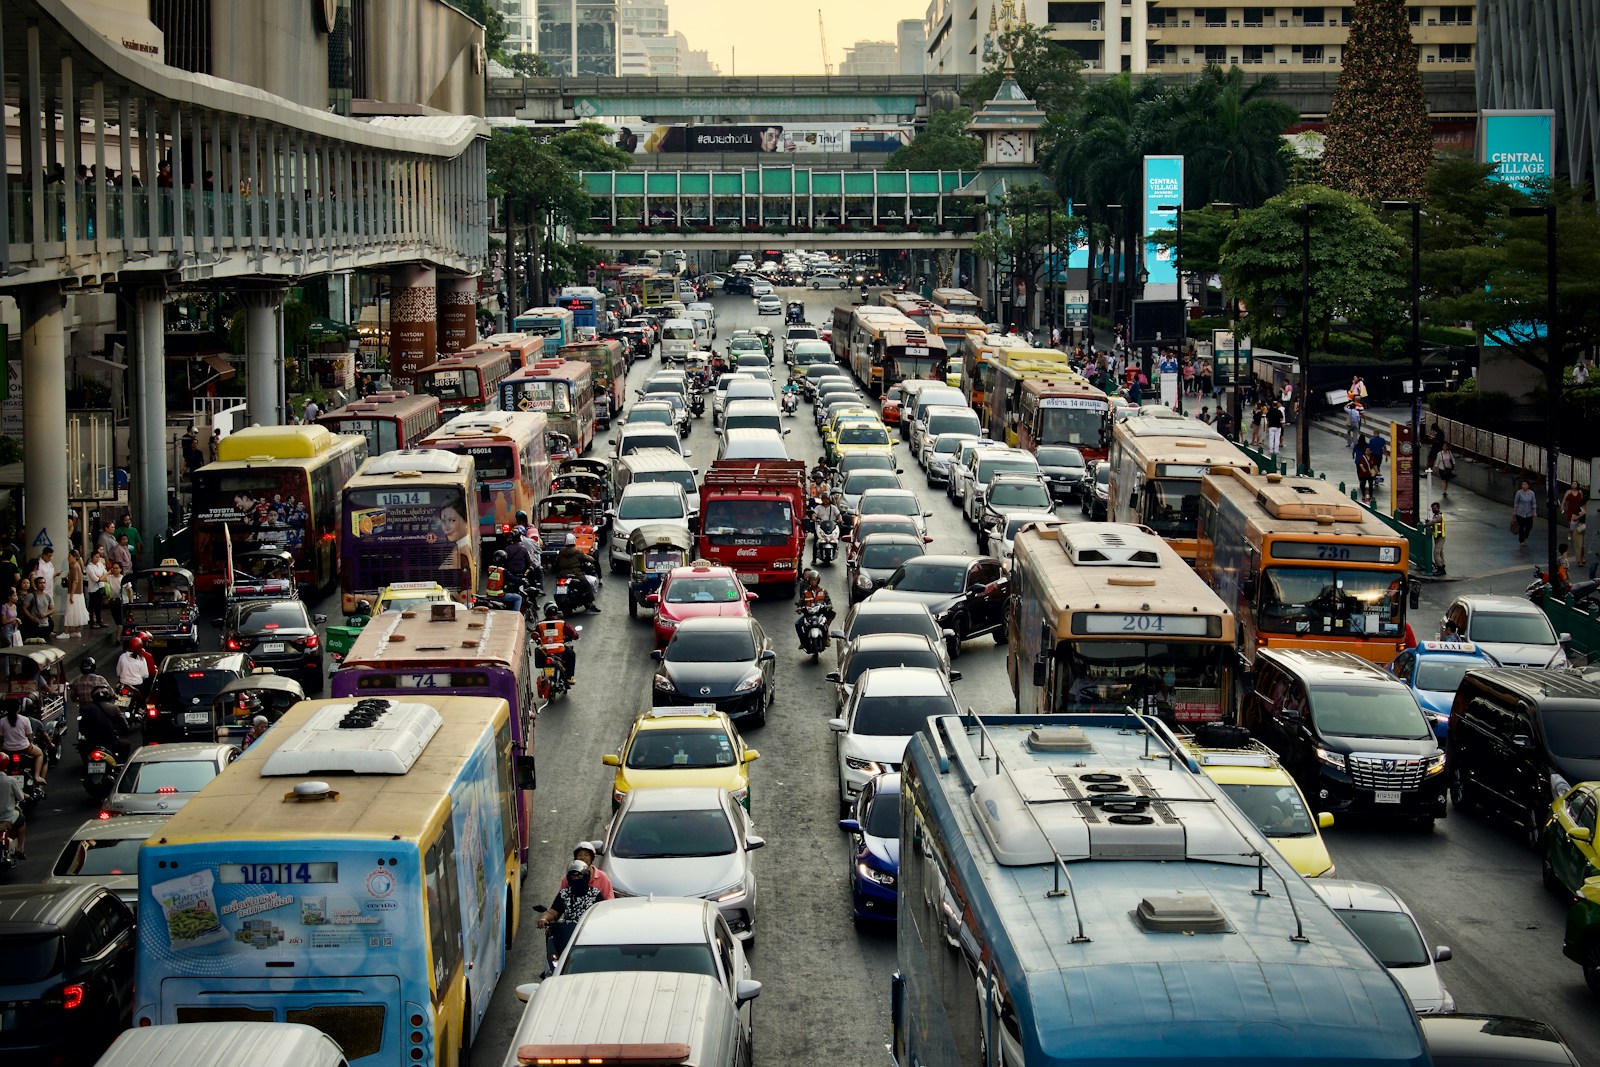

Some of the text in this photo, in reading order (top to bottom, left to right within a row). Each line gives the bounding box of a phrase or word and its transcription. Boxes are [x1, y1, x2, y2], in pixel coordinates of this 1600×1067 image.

[1492, 153, 1544, 162] CENTRAL
[1149, 178, 1179, 186] CENTRAL
[527, 401, 551, 410] PUMA
[1071, 400, 1079, 408] 14
[352, 421, 361, 430] 13
[382, 492, 420, 505] ปอ.14
[1122, 616, 1165, 631] 204
[328, 639, 343, 648] Grab
[412, 674, 437, 687] 74
[240, 863, 313, 885] ปอ.14
